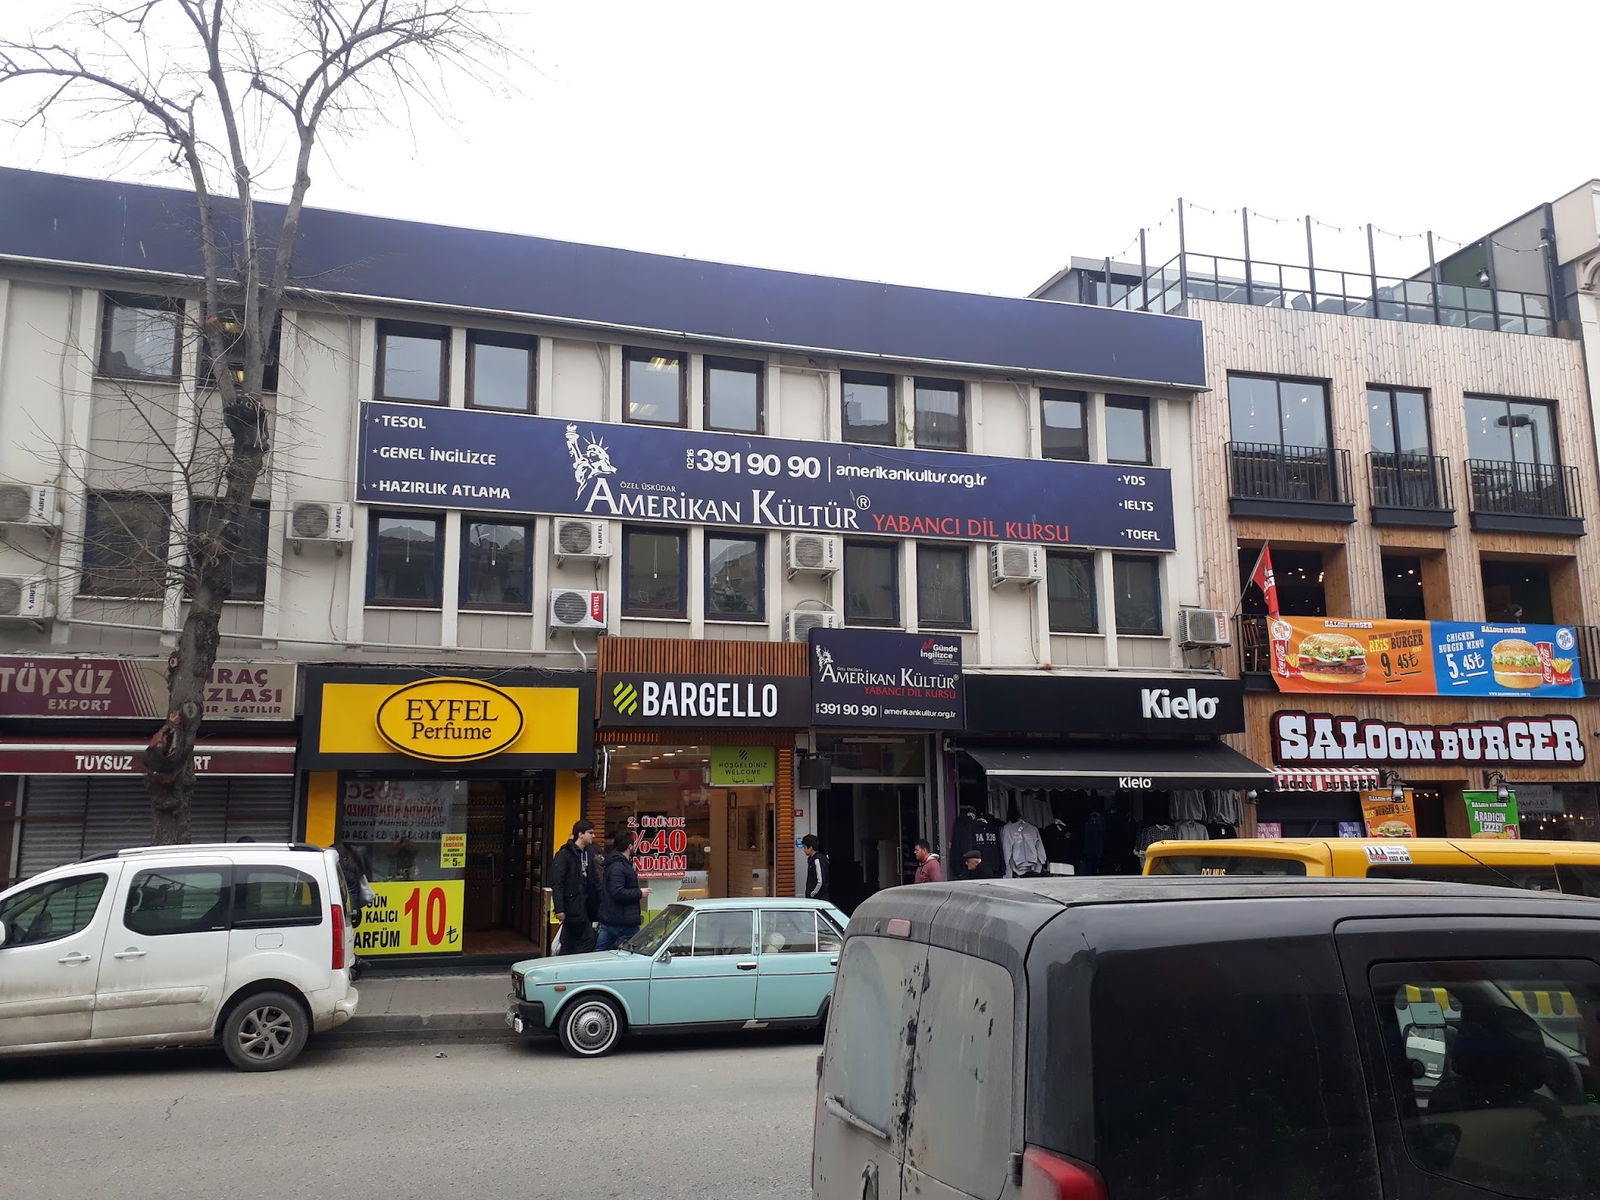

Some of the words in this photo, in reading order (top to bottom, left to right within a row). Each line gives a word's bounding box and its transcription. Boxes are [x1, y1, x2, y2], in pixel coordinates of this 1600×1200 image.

[381, 415, 426, 429] TESOL
[380, 446, 426, 460] GENEL
[430, 446, 497, 466] İNGİLİZCE
[686, 448, 695, 470] 0216
[696, 448, 741, 474] 391
[746, 453, 781, 476] 90
[787, 455, 821, 479] 90
[836, 464, 987, 489] amerikankultur.org.tr
[619, 480, 640, 491] ÖZEL
[1122, 474, 1146, 486] YDS
[379, 480, 448, 496] HAZIRLIK
[451, 484, 511, 500] ATLAMA
[584, 476, 741, 523] AMERİKAN
[752, 489, 860, 530] KÜLTÜR
[1124, 499, 1154, 512] IELTS
[872, 513, 961, 536] YABANCI
[967, 517, 1000, 538] DİL
[1005, 521, 1070, 543] KURSU
[1126, 528, 1161, 541] TOEFL
[1391, 634, 1424, 649] BURGER
[1446, 632, 1475, 642] CHICKEN
[933, 644, 959, 652] Günde
[1438, 642, 1464, 653] BURGER
[0, 662, 113, 696] TÜYSÜZ
[820, 664, 896, 686] AMERİKAN
[901, 668, 955, 689] KÜLTÜR
[642, 682, 778, 717] BARGELLO
[864, 687, 905, 697] YABANCI
[925, 690, 956, 699] KURSU
[48, 699, 111, 711] EXPORT
[405, 699, 499, 722] EYFEL
[820, 703, 840, 715] 391
[842, 704, 858, 716] 90
[861, 705, 877, 716] 90
[883, 708, 956, 719] amerikankultur.org.tr
[1141, 688, 1217, 719] Kielo
[411, 722, 492, 740] Perfume
[1279, 715, 1434, 761] SALOON
[1438, 719, 1585, 761] BURGER
[75, 755, 133, 770] TUYSUZ
[1119, 777, 1151, 789] Kielo
[1326, 779, 1378, 790] BURGER
[627, 817, 639, 828] 2.
[641, 815, 686, 828] ÜRÜNDE
[1480, 822, 1503, 833] LEZZET
[632, 853, 687, 872] NDİRİM
[365, 910, 398, 923] KALICI
[404, 887, 447, 946] 10
[354, 927, 400, 949] ARFÜM
